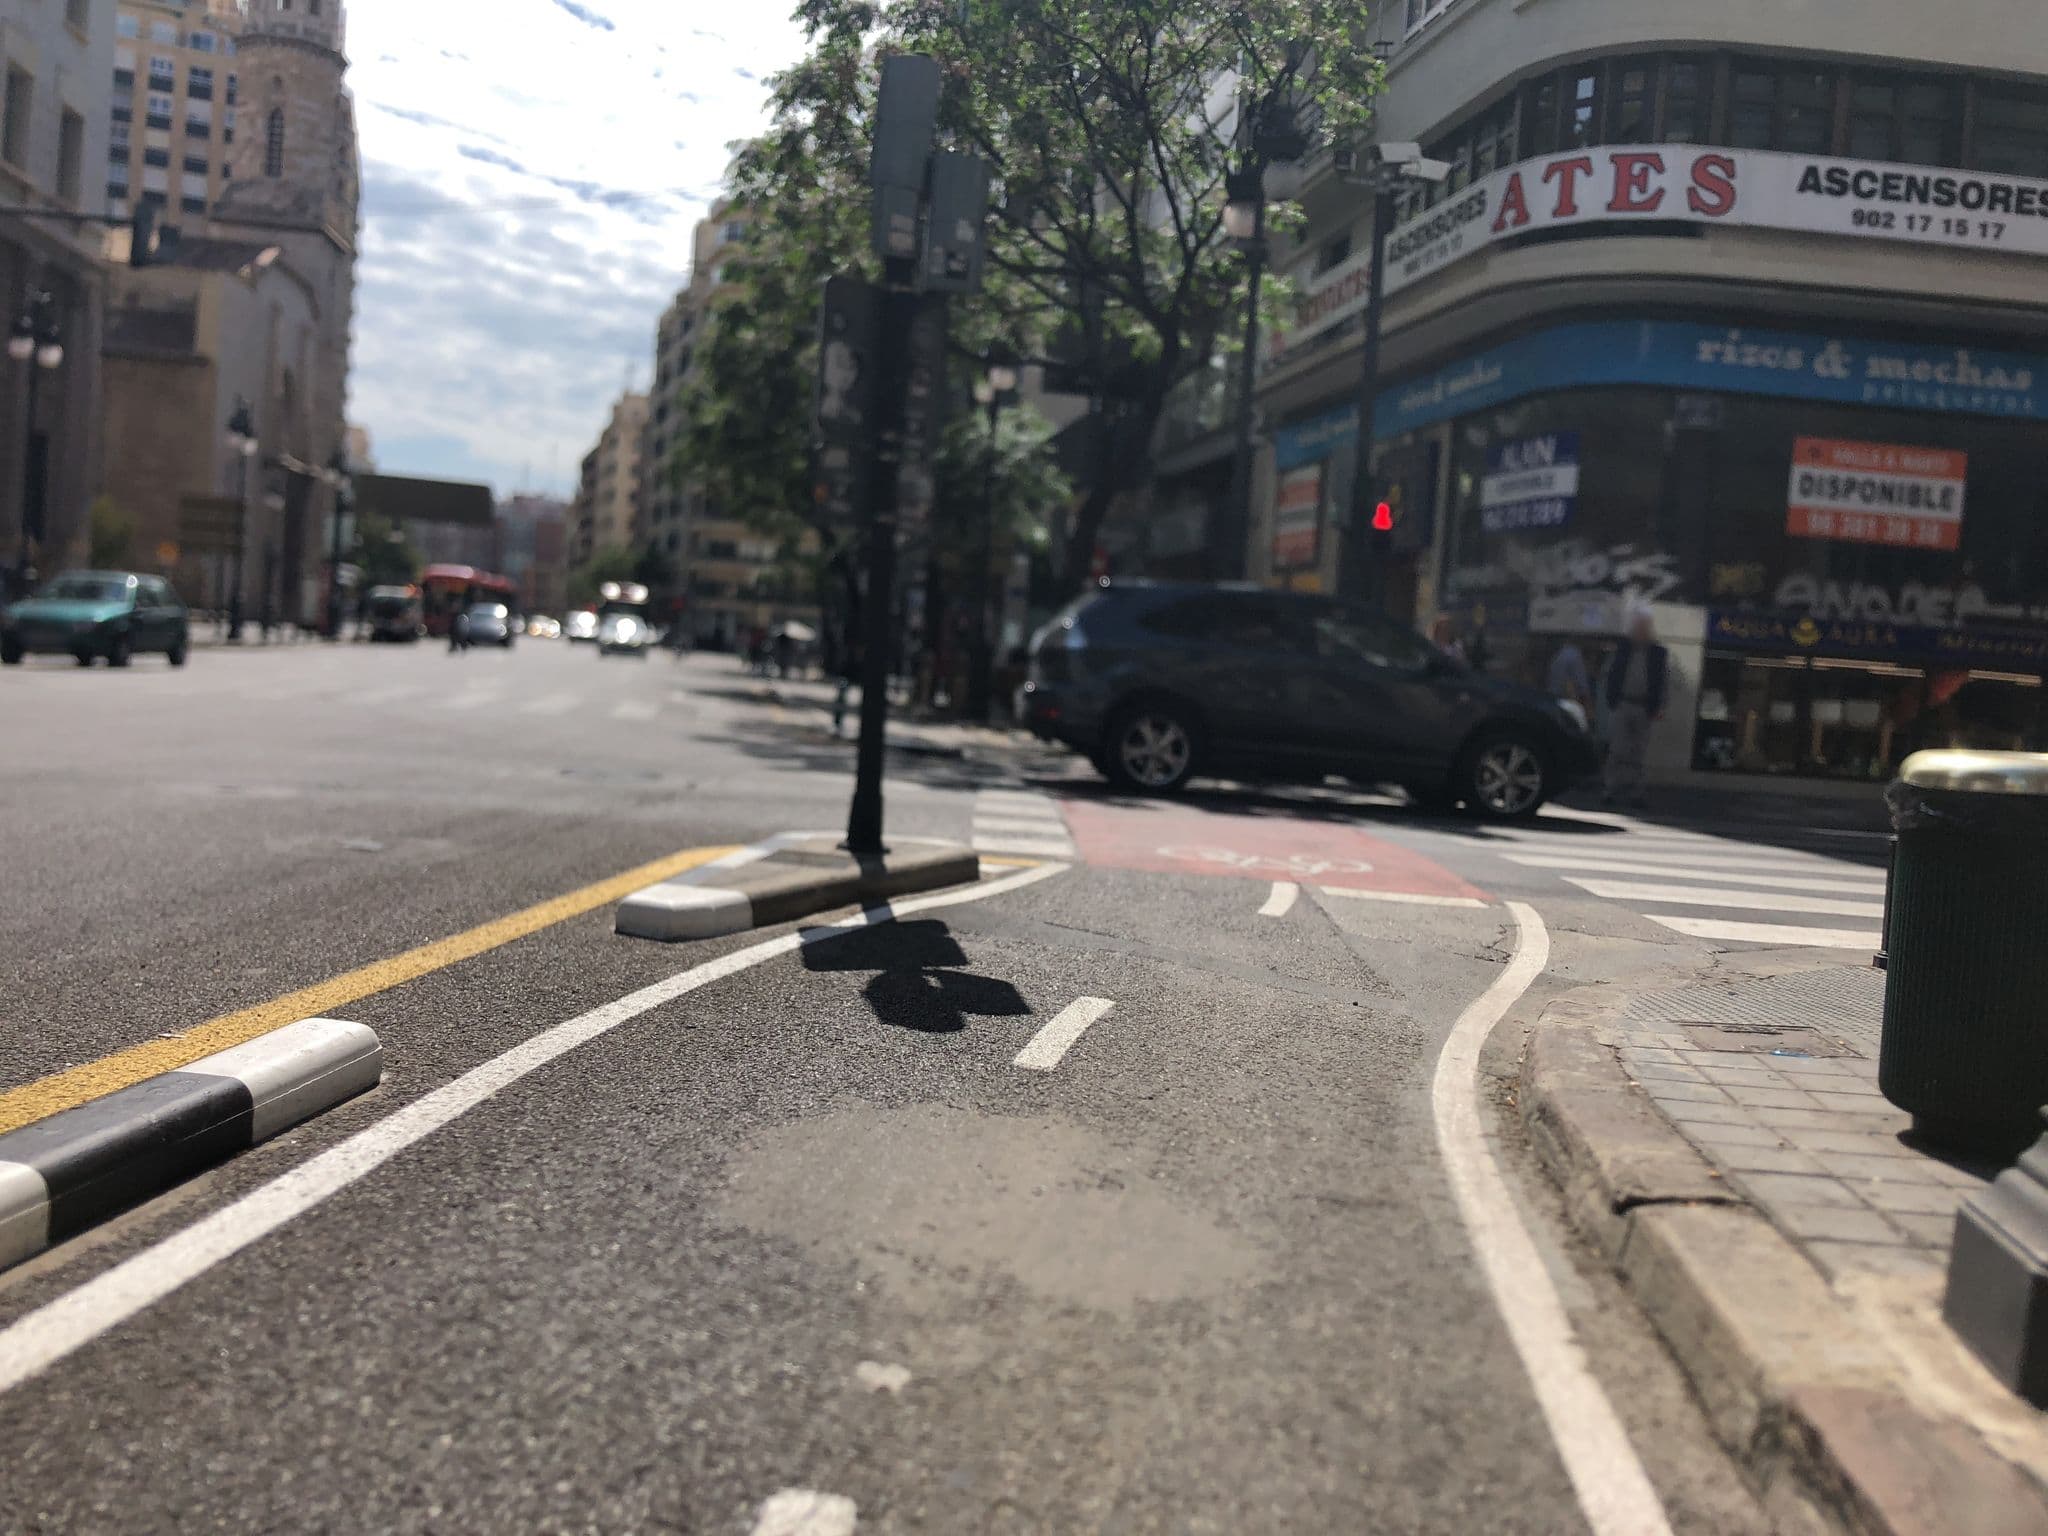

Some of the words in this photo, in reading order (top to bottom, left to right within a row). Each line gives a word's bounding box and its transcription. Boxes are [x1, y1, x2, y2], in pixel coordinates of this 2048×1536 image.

[1491, 153, 1737, 233] ATES
[1852, 207, 1896, 230] 902
[1904, 213, 1932, 233] 17
[1943, 217, 1970, 237] 15
[1980, 221, 2007, 241] 17
[1813, 339, 1850, 379] &
[1865, 351, 2034, 392] mechas
[1799, 471, 1955, 513] DISPONIBLE
